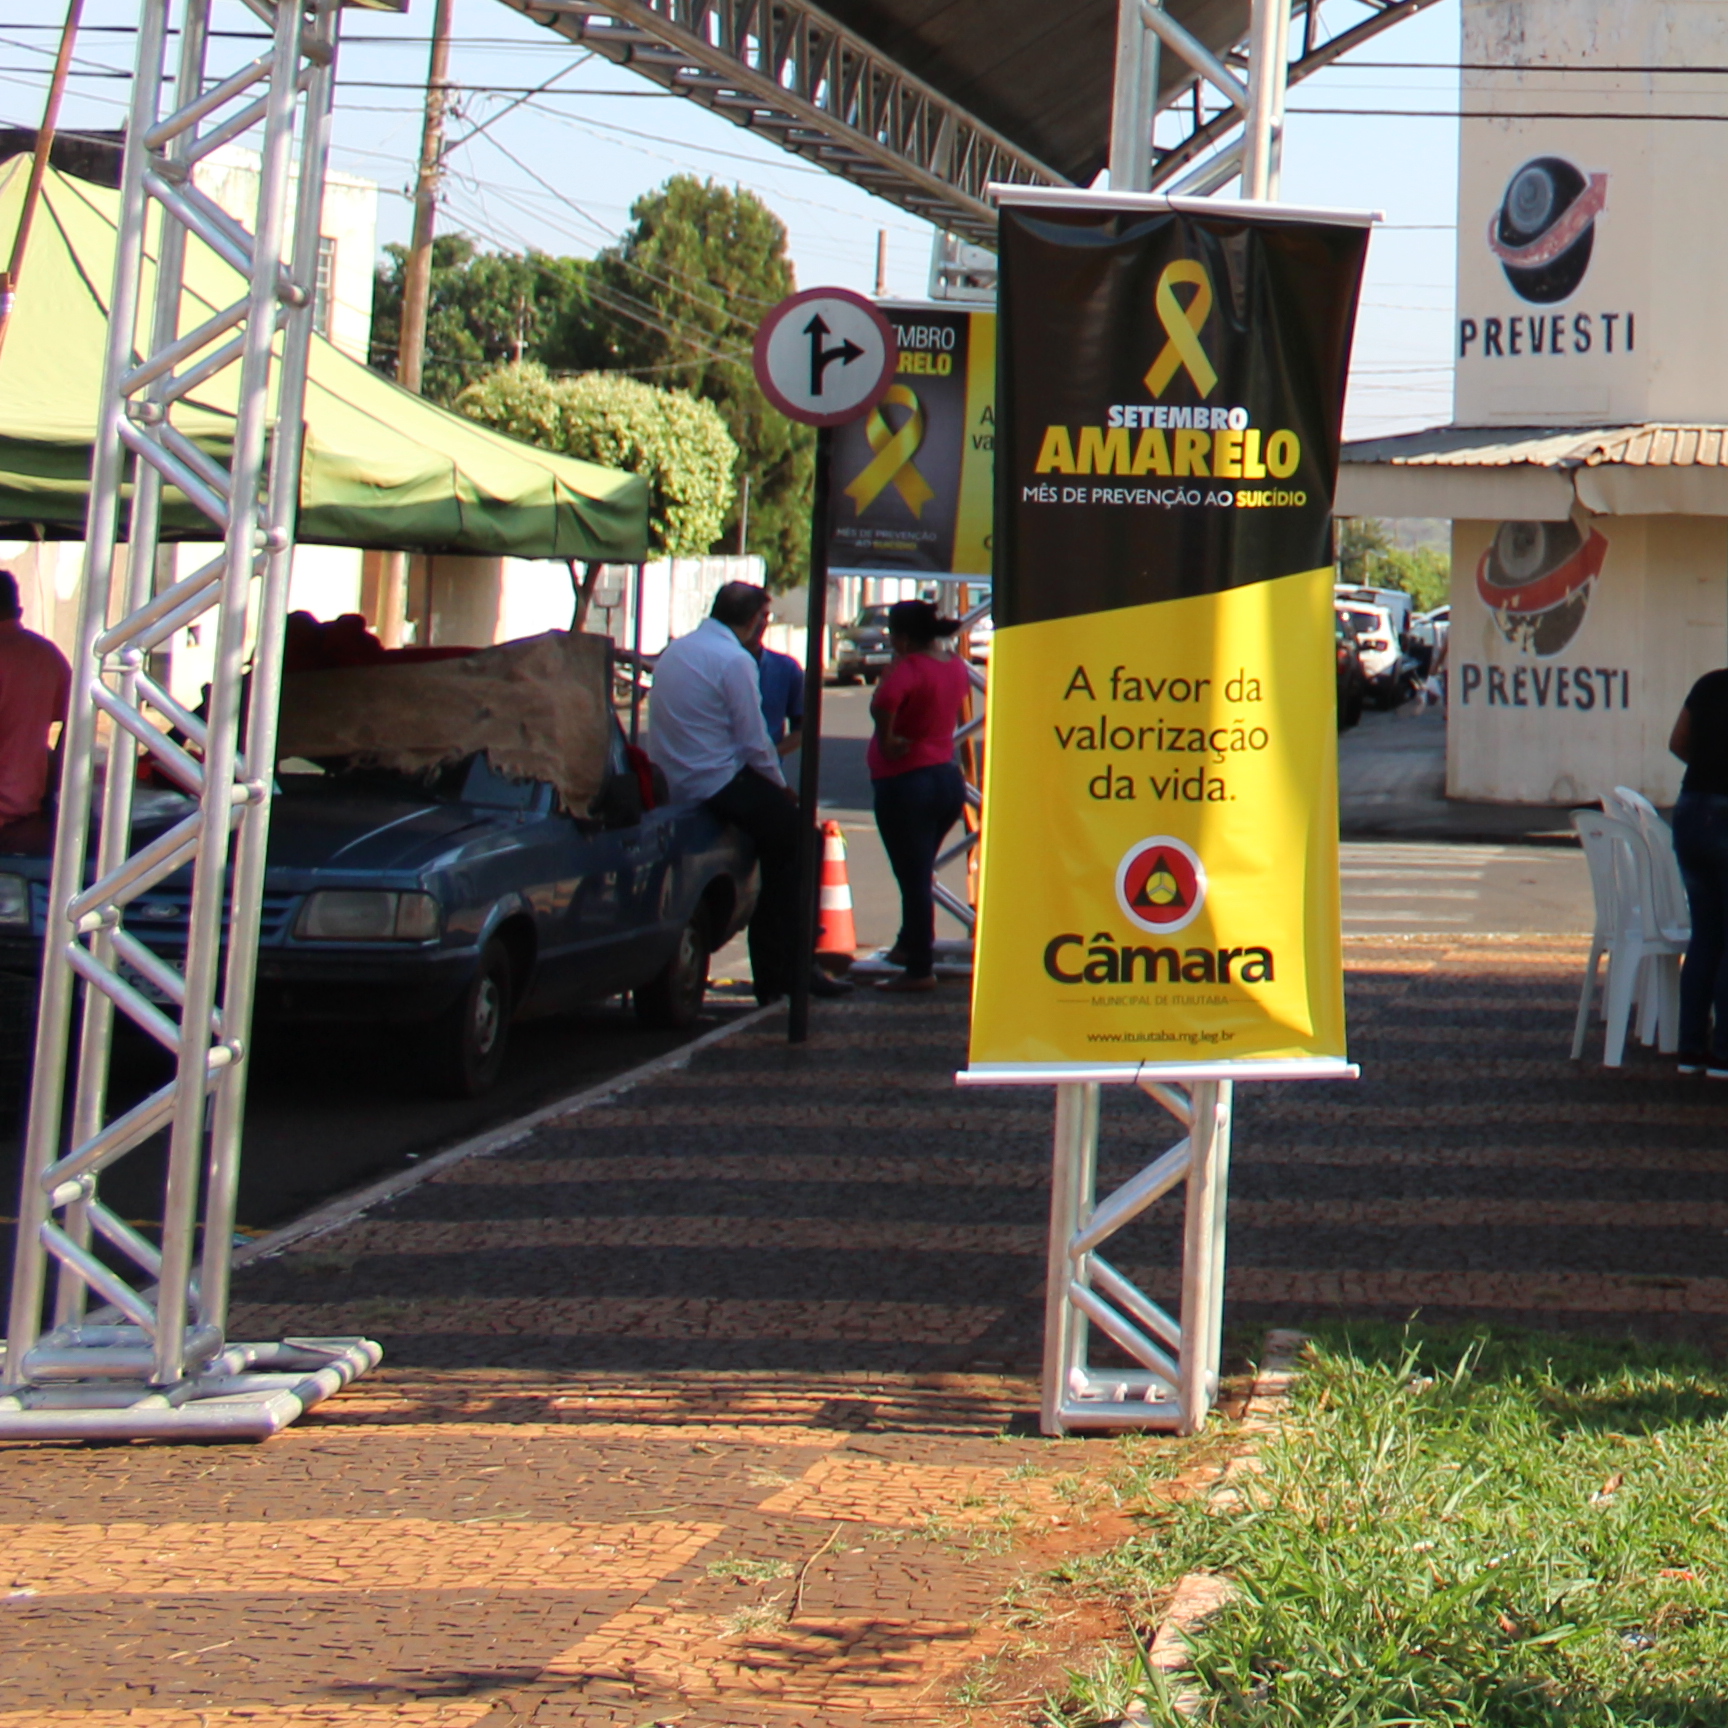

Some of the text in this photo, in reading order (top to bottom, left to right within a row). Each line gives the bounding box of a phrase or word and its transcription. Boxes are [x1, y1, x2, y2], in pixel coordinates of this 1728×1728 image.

[1459, 312, 1636, 358] PREVESTI
[1108, 404, 1249, 430] SETEMBRO
[1034, 425, 1302, 480] AMARELO
[1023, 482, 1307, 510] MÊS DE PREVENÇÃO AO SUICÍDIO
[1063, 665, 1264, 703] A favor da
[1461, 663, 1630, 711] PREVESTI
[1054, 715, 1270, 763] valorização
[1089, 765, 1237, 802] da vida.
[1042, 931, 1275, 985] Câmara
[1091, 995, 1230, 1007] MUNICIPAL DE ITUIUTABA
[1087, 1029, 1236, 1045] www.ituiutaba.mg.leg.br
